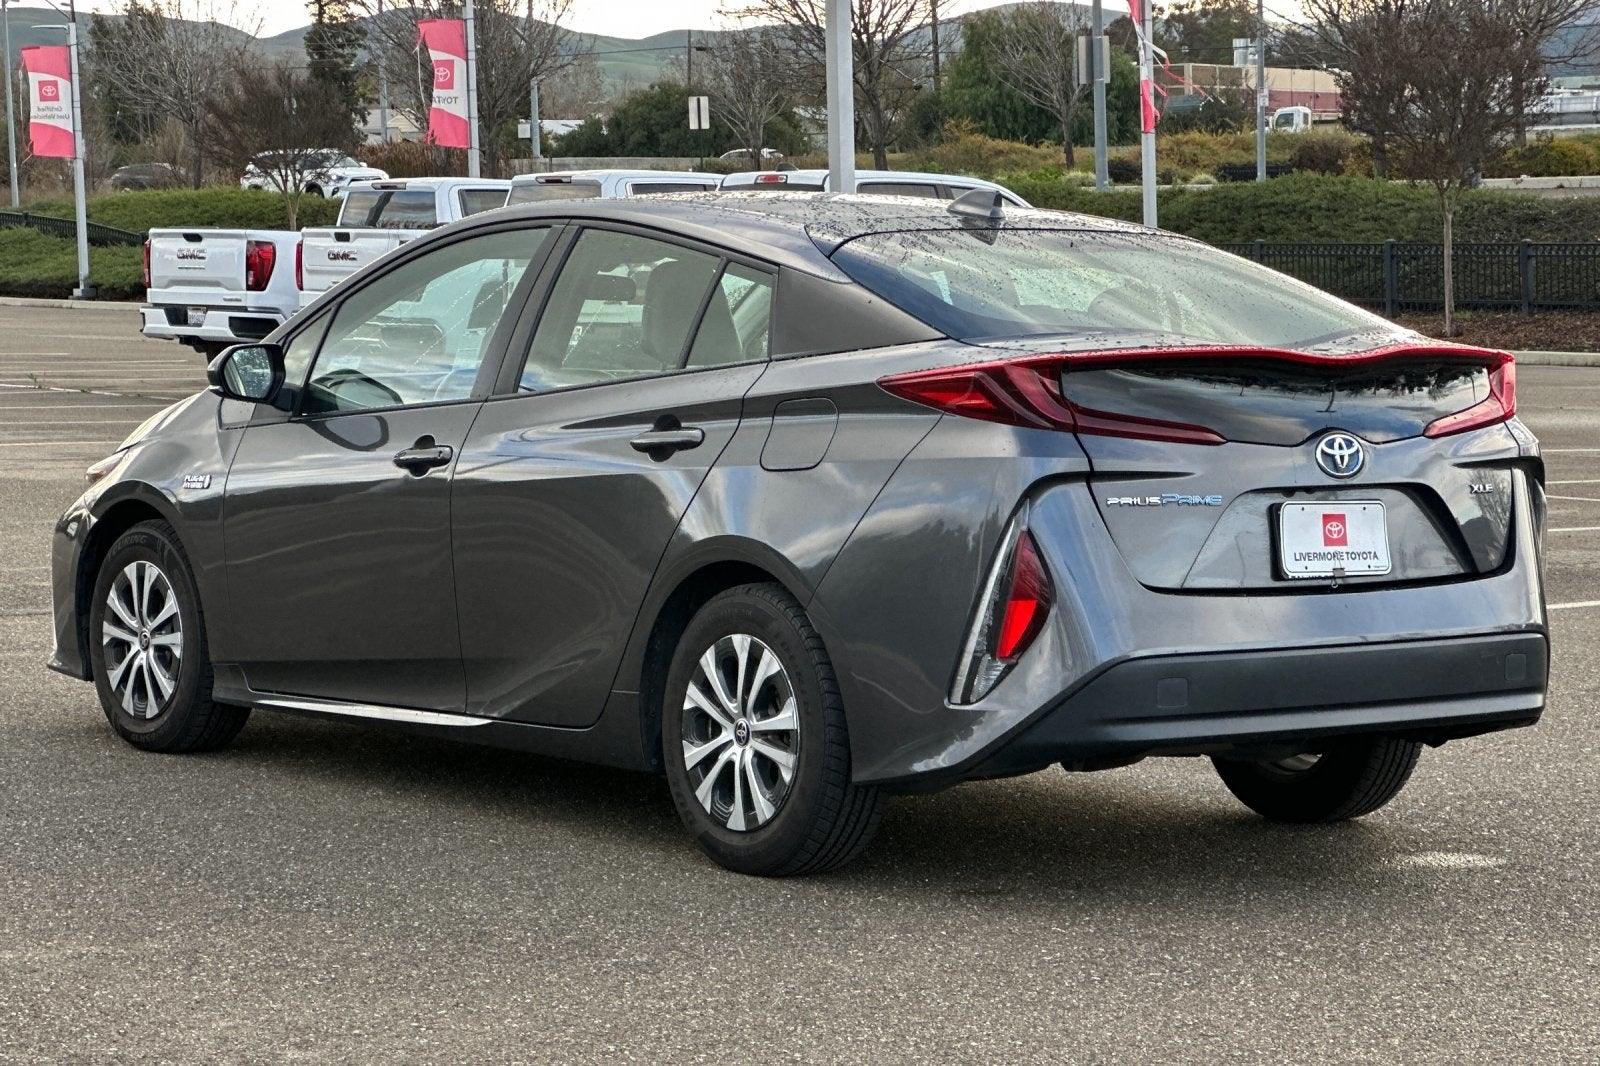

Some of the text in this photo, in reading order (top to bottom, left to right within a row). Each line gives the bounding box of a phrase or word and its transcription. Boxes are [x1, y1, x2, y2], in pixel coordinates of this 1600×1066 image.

[177, 248, 207, 260] GMC
[327, 249, 358, 261] GMC
[1469, 483, 1494, 494] XLE
[1106, 493, 1223, 506] PRIUS PRIME
[1293, 551, 1379, 562] LIVERMORE TOYOTA
